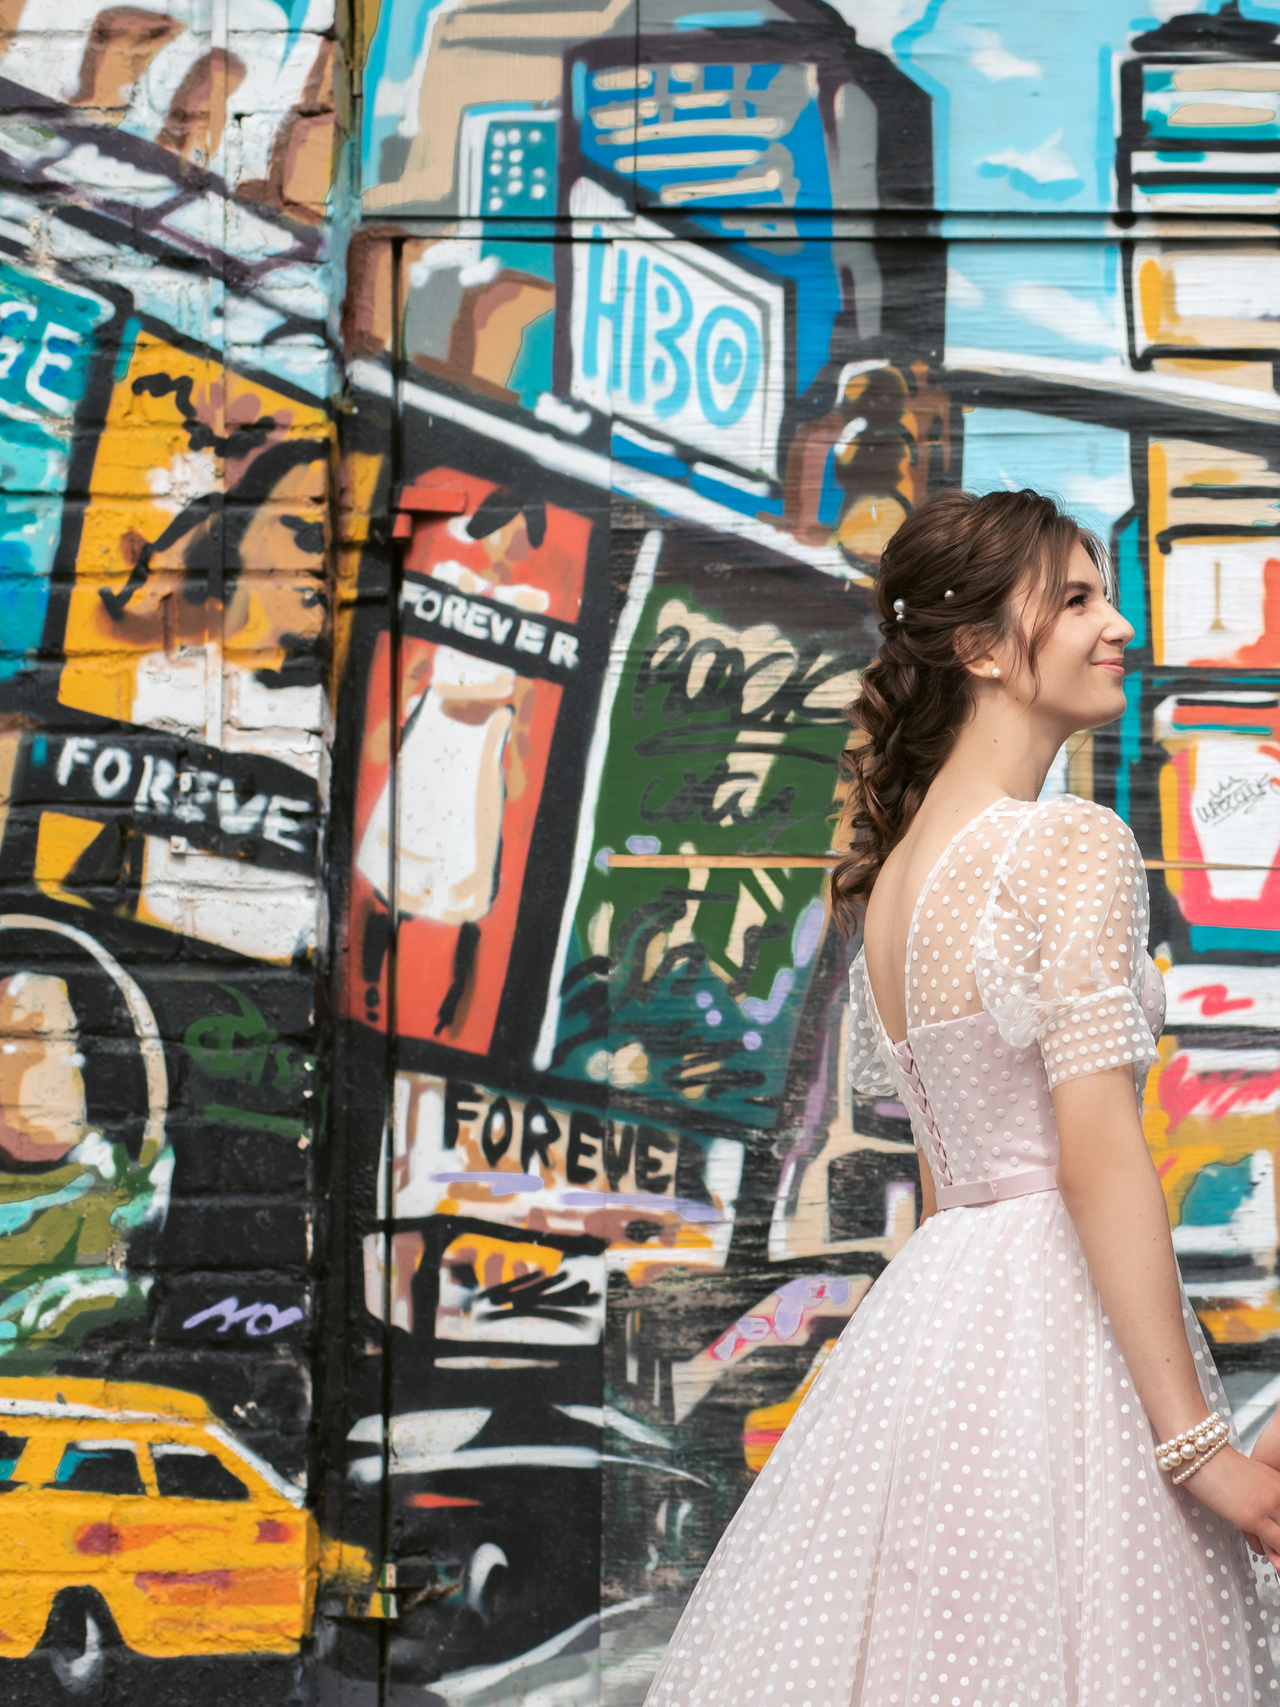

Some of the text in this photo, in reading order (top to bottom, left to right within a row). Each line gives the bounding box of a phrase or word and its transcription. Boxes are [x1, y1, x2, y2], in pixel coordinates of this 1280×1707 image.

[582, 223, 762, 430] HBO
[398, 580, 579, 669] FOREVER
[56, 737, 312, 853] FOREVE
